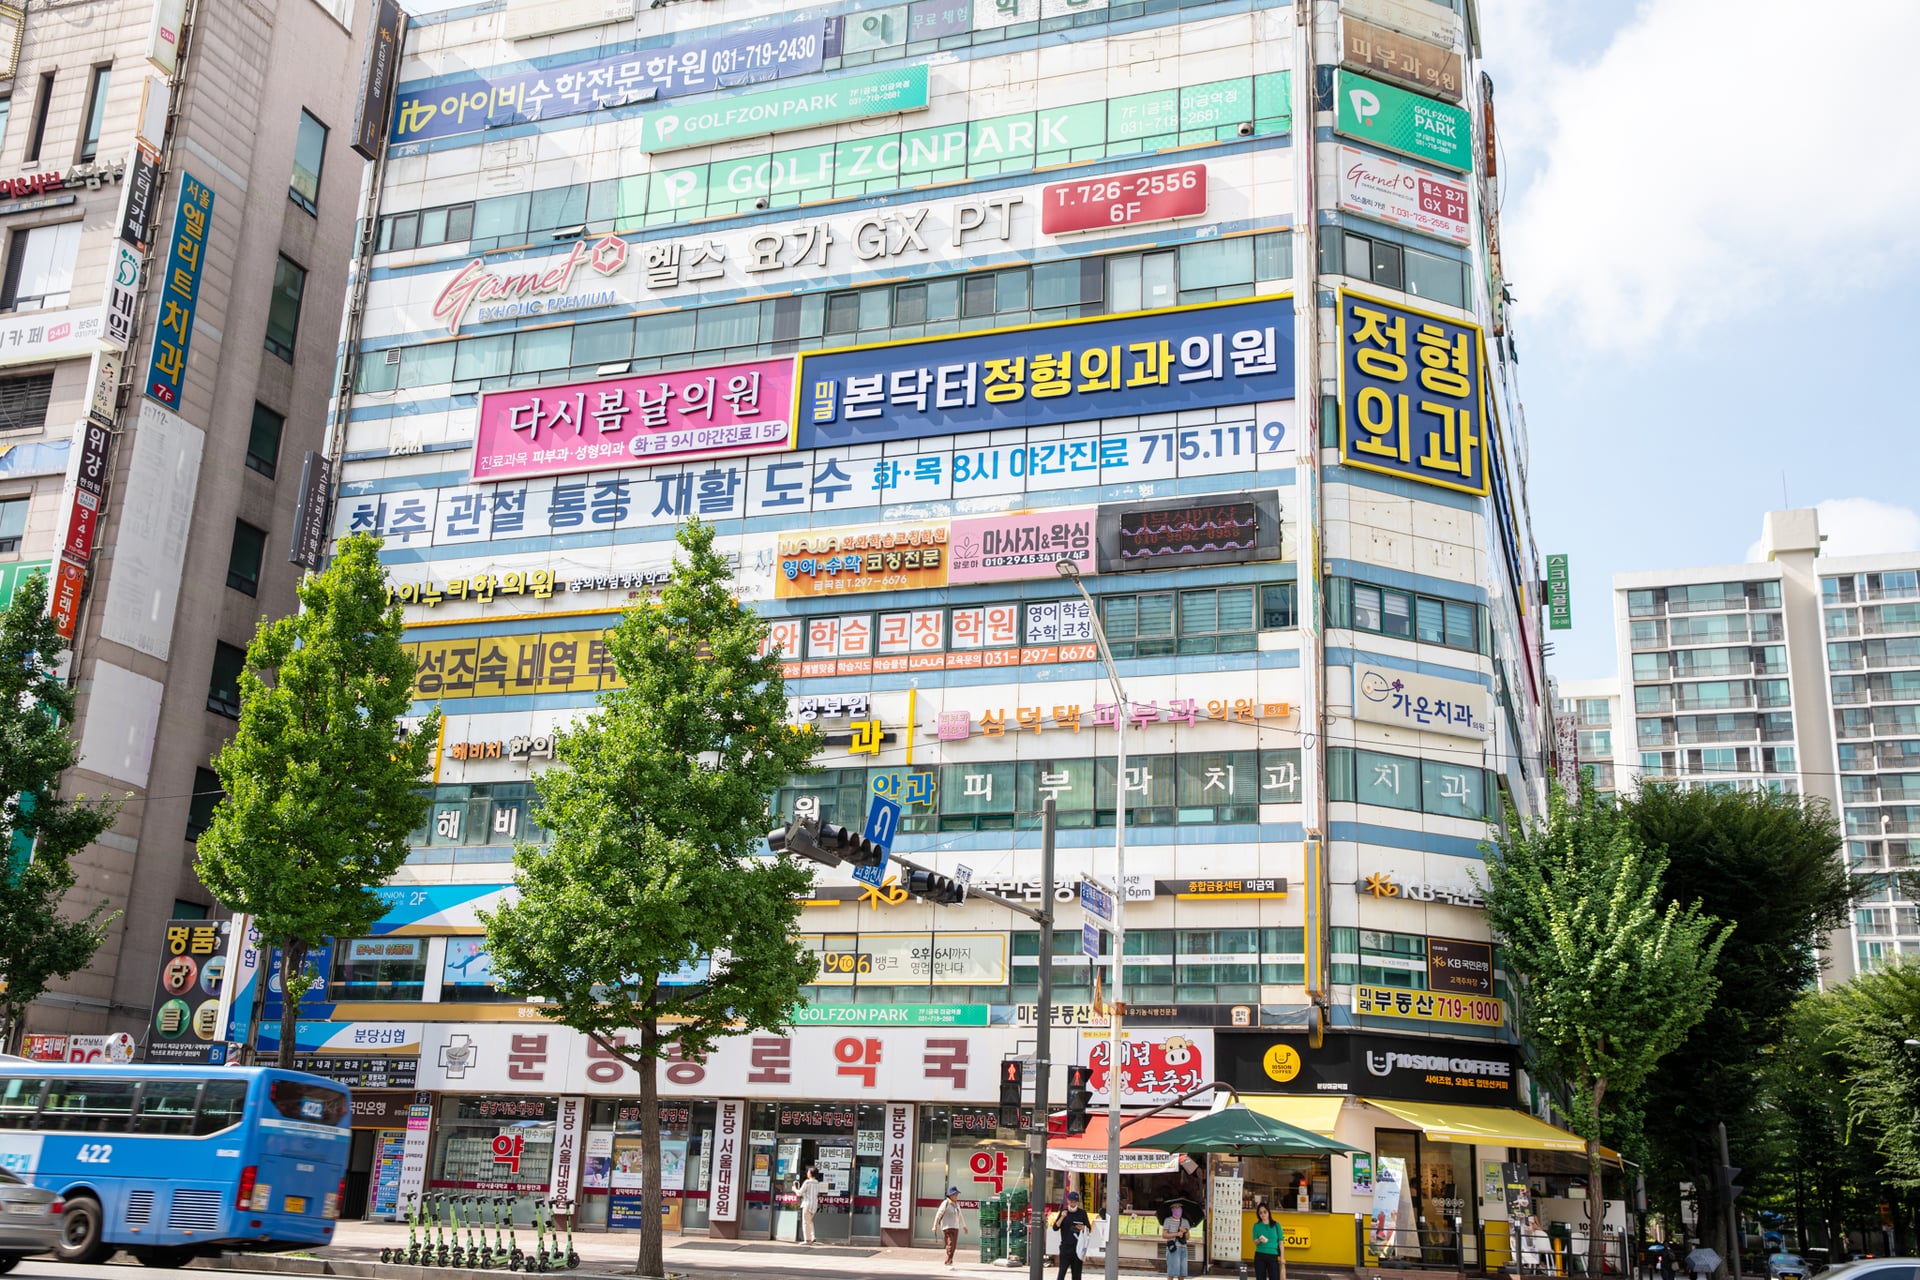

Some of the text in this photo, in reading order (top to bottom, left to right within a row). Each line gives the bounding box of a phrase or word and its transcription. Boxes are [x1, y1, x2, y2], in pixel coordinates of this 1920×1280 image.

[911, 14, 937, 28] 무료
[712, 34, 816, 76] 031-719-2430
[1352, 36, 1455, 91] 피부과 의원
[684, 92, 838, 132] GOLFZON PARK
[1414, 104, 1456, 125] GOLFZON
[1414, 113, 1457, 139] PARK
[1056, 170, 1197, 206] T.726-2556
[1346, 162, 1400, 190] Garnet
[128, 166, 152, 240] 스터디카페
[186, 179, 211, 210] 서울
[1421, 181, 1442, 198] 헬스
[1445, 189, 1466, 205] 요가
[1110, 202, 1142, 223] 6F
[1423, 197, 1465, 220] GX PT
[644, 196, 1023, 289] 헬스 요가 GX PT
[154, 201, 206, 387] 엘리트치과
[432, 240, 588, 334] Garnet
[109, 287, 134, 344] 네일
[478, 290, 616, 321] EXHOLIC PREMIUM
[49, 323, 69, 341] 24시
[1352, 305, 1472, 399] 정형
[813, 325, 1278, 422] 미금 본닥터정형외과의원
[155, 383, 175, 403] 7F
[508, 369, 765, 441] 다시봄날의원
[671, 430, 695, 450] 9시
[697, 426, 753, 450] 야간진료
[762, 422, 782, 439] 5F
[1354, 385, 1480, 478] 외과
[84, 427, 105, 478] 위강
[480, 451, 528, 471] 진료과목
[79, 476, 102, 493] 한의원
[446, 486, 528, 538] 관절
[547, 477, 632, 531] 통증
[651, 467, 742, 519] 재활
[760, 456, 852, 508] 도수
[953, 449, 1000, 483] 8시
[1008, 437, 1129, 480] 야간진료
[1138, 419, 1287, 467] 715.1119
[982, 521, 1090, 556] 마사지&왁싱
[865, 547, 940, 573] 코칭전문
[1550, 556, 1570, 618] 스크린골프
[57, 578, 75, 630] 노래방
[1028, 600, 1091, 623] 영어 학습
[810, 619, 870, 654] 학습
[879, 612, 943, 649] 코칭
[952, 607, 1015, 642] 학원
[1028, 621, 1092, 641] 수학 코칭
[416, 639, 577, 694] 성조숙 비염
[783, 666, 800, 676] 수능
[802, 661, 836, 675] 개별맞춤
[837, 660, 871, 674] 학습지도
[947, 654, 982, 668] 교육문의
[799, 695, 869, 721] 정보원
[979, 703, 1081, 738] 심덕택
[1092, 697, 1200, 731] 피부과
[1206, 697, 1256, 722] 의원
[1392, 694, 1473, 728] 가온치과
[451, 733, 560, 763] 해비치 한의
[871, 772, 937, 807] 안과
[409, 891, 428, 906] 2F
[1188, 879, 1275, 892] 종합금융센터 미금역
[166, 926, 217, 955] 명품
[910, 947, 971, 960] 오후 6시까지
[168, 964, 226, 989] 당구
[874, 956, 899, 970] 뱅크
[910, 962, 963, 975] 영업 합니다
[1447, 957, 1489, 972] KB국민은행
[798, 1007, 909, 1023] GOLFZON PARK
[1359, 987, 1500, 1023] 미래 부동산 719-1900
[159, 1007, 218, 1034] 클럽
[354, 1028, 406, 1045] 분당신협
[316, 1059, 417, 1071] 내과 안과 골프존
[1449, 1059, 1512, 1078] COFFEE
[1455, 1077, 1476, 1088] 오늘도
[76, 1144, 113, 1163] 422
[491, 1134, 525, 1174] 약
[555, 1100, 577, 1210] 분당 서울대병원
[716, 1103, 738, 1217] 분당 서울대병원
[886, 1107, 907, 1224] 분당 서울대병원
[969, 1151, 1009, 1194] 약
